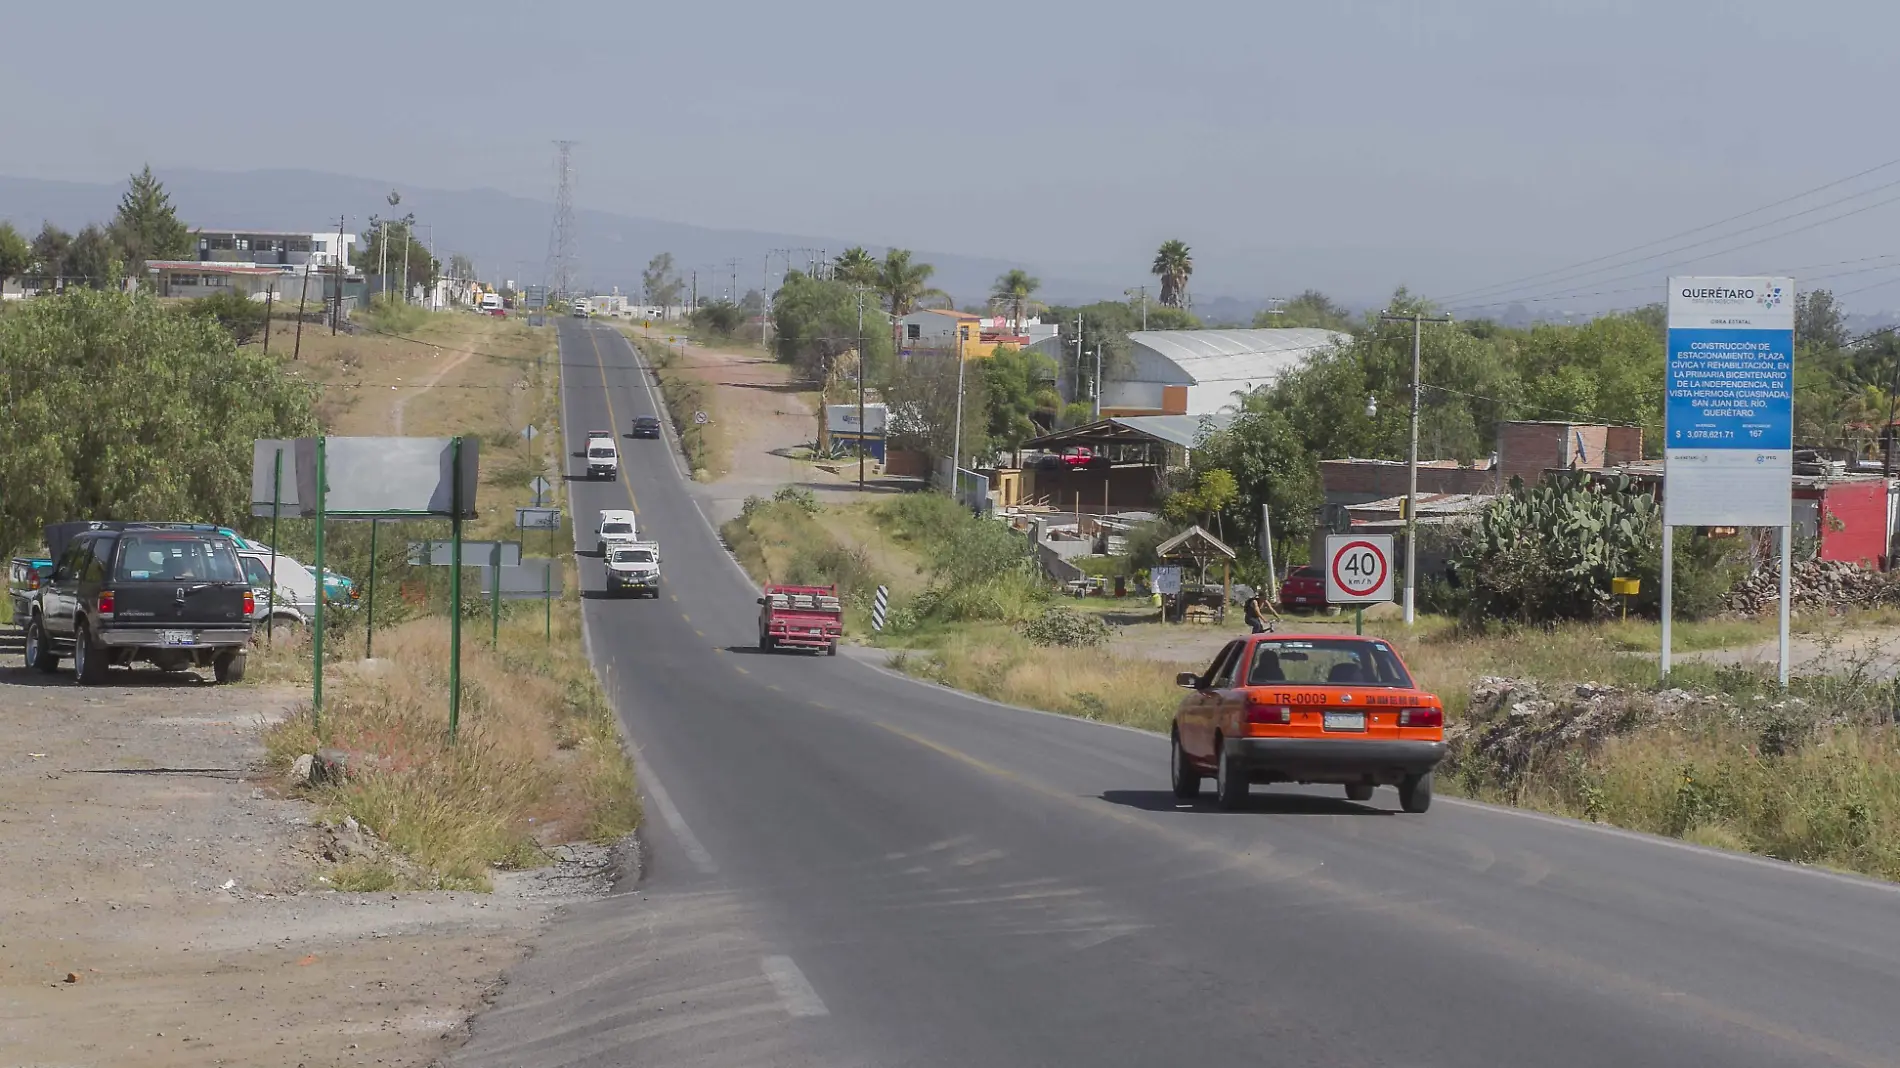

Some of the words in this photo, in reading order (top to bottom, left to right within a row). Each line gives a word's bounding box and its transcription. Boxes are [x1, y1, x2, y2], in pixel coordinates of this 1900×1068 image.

[1682, 287, 1754, 299] QUERÉTARO
[1691, 342, 1757, 350] CONSTRUCCIÓN
[1671, 361, 1698, 369] CÍVICA
[1778, 362, 1790, 370] EN
[1725, 371, 1787, 379] BICENTENARIO
[1677, 380, 1688, 388] DE
[1690, 380, 1700, 388] LA
[1771, 381, 1784, 389] EN
[1693, 390, 1736, 398] HERMOSA
[1675, 430, 1681, 438] $
[1345, 552, 1375, 576] 40
[1273, 693, 1327, 705] TR-0009
